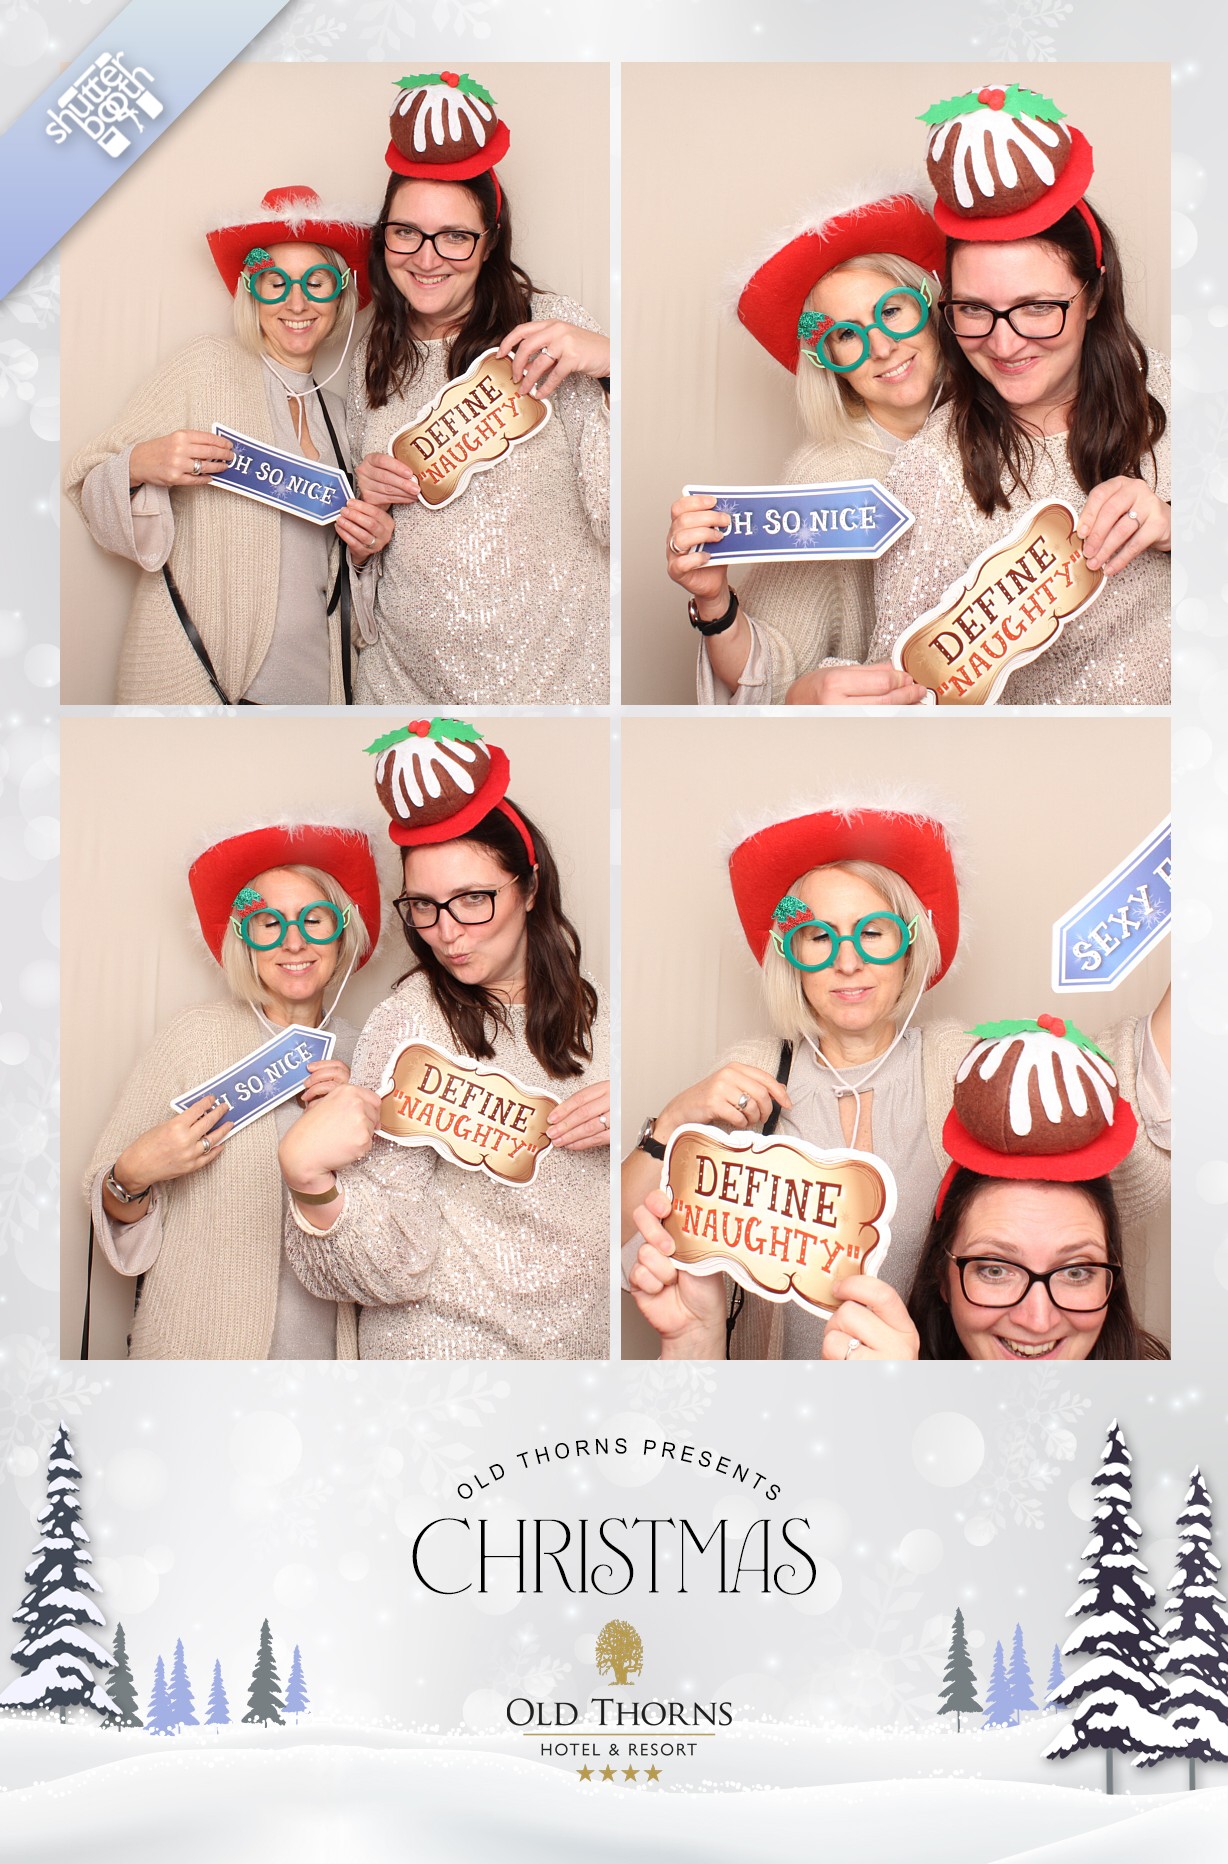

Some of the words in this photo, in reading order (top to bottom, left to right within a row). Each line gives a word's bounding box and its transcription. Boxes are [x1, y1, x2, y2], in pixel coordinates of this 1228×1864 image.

[409, 374, 504, 461] DEFINE
[255, 461, 284, 486] SO
[287, 475, 337, 505] NICE
[762, 509, 801, 535] SO
[809, 505, 877, 532] NICE
[928, 535, 1057, 666] DEFINE
[1072, 884, 1154, 971] SEXY
[234, 1074, 264, 1102] SO
[263, 1041, 313, 1084] NICE
[416, 1063, 536, 1133] DEFINE
[694, 1154, 843, 1229] DEFINE
